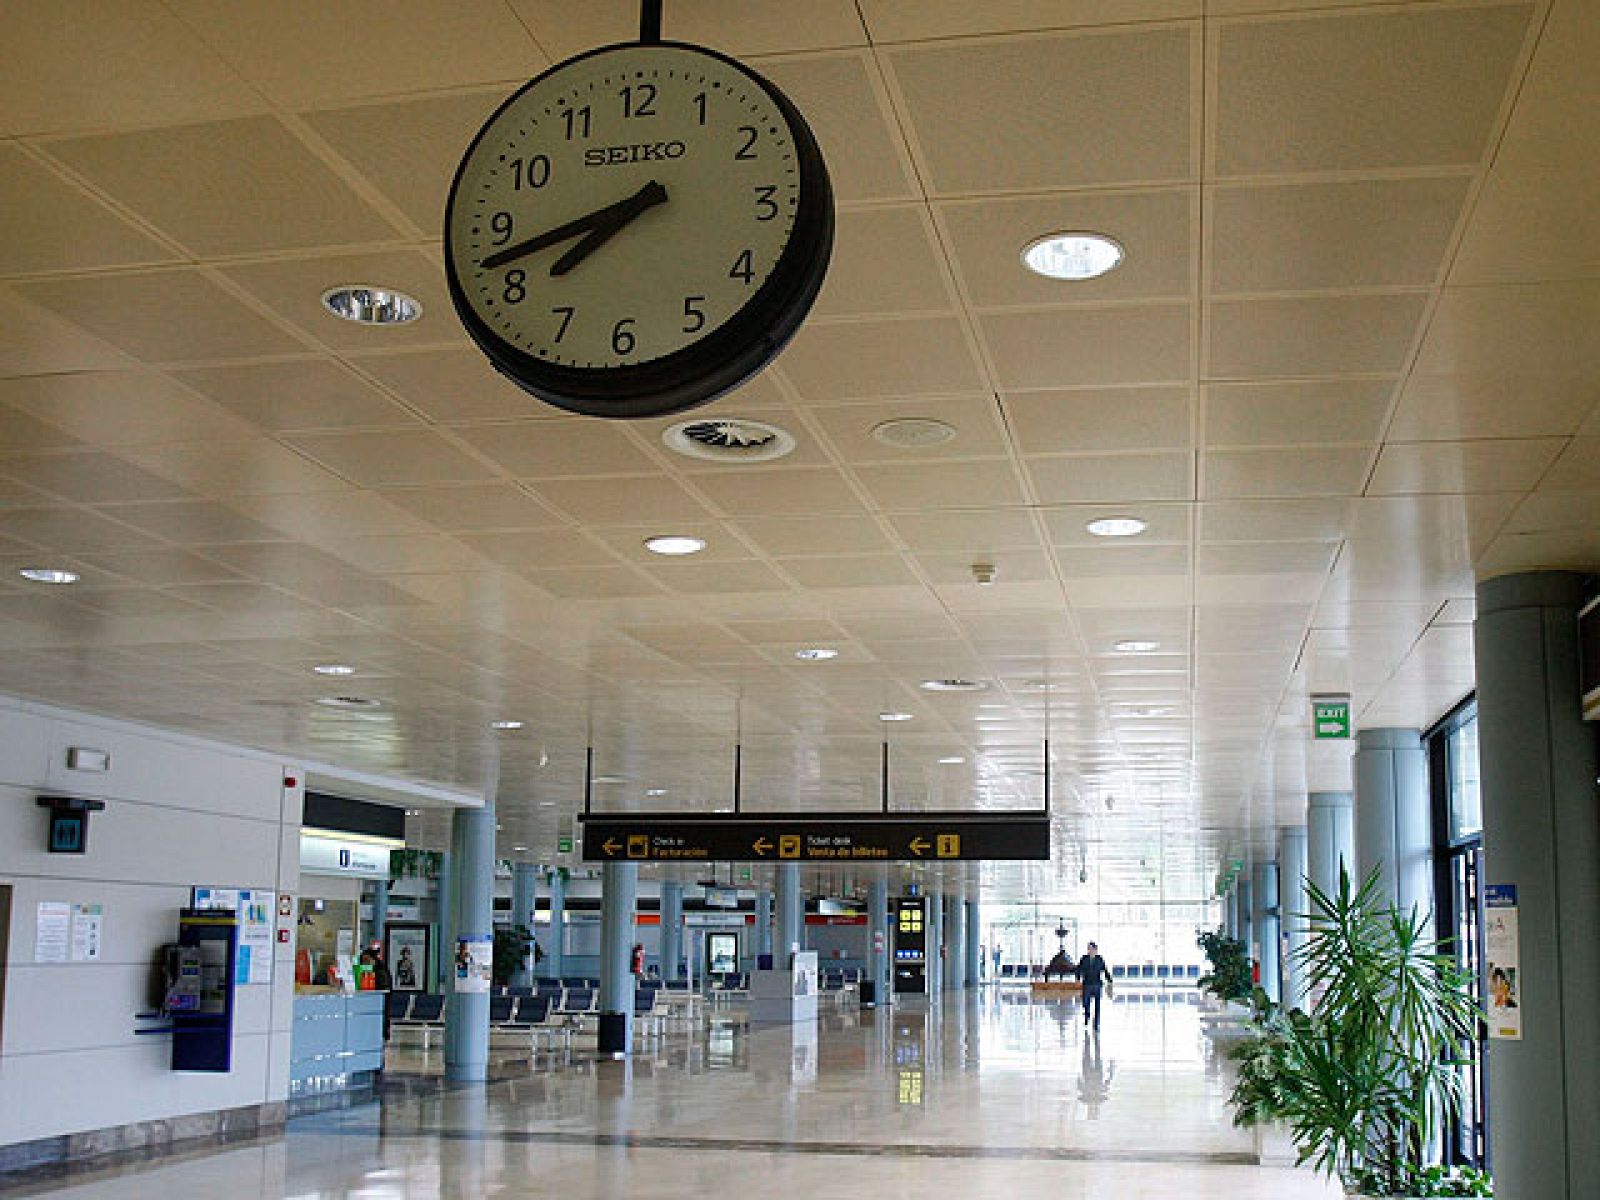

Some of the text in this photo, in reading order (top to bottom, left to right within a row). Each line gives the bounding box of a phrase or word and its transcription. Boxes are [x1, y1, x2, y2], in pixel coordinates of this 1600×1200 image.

[619, 84, 657, 118] 12
[691, 91, 706, 125] 1
[560, 105, 591, 140] 11
[584, 141, 686, 166] SEIKO
[735, 126, 758, 161] 2
[510, 154, 550, 190] 10
[755, 185, 778, 221] 3
[492, 212, 513, 246] 9
[729, 249, 755, 285] 4
[504, 269, 525, 303] 8
[552, 307, 574, 343] 7
[683, 296, 705, 333] 5
[612, 319, 635, 356] 6
[1317, 708, 1345, 718] EXIT
